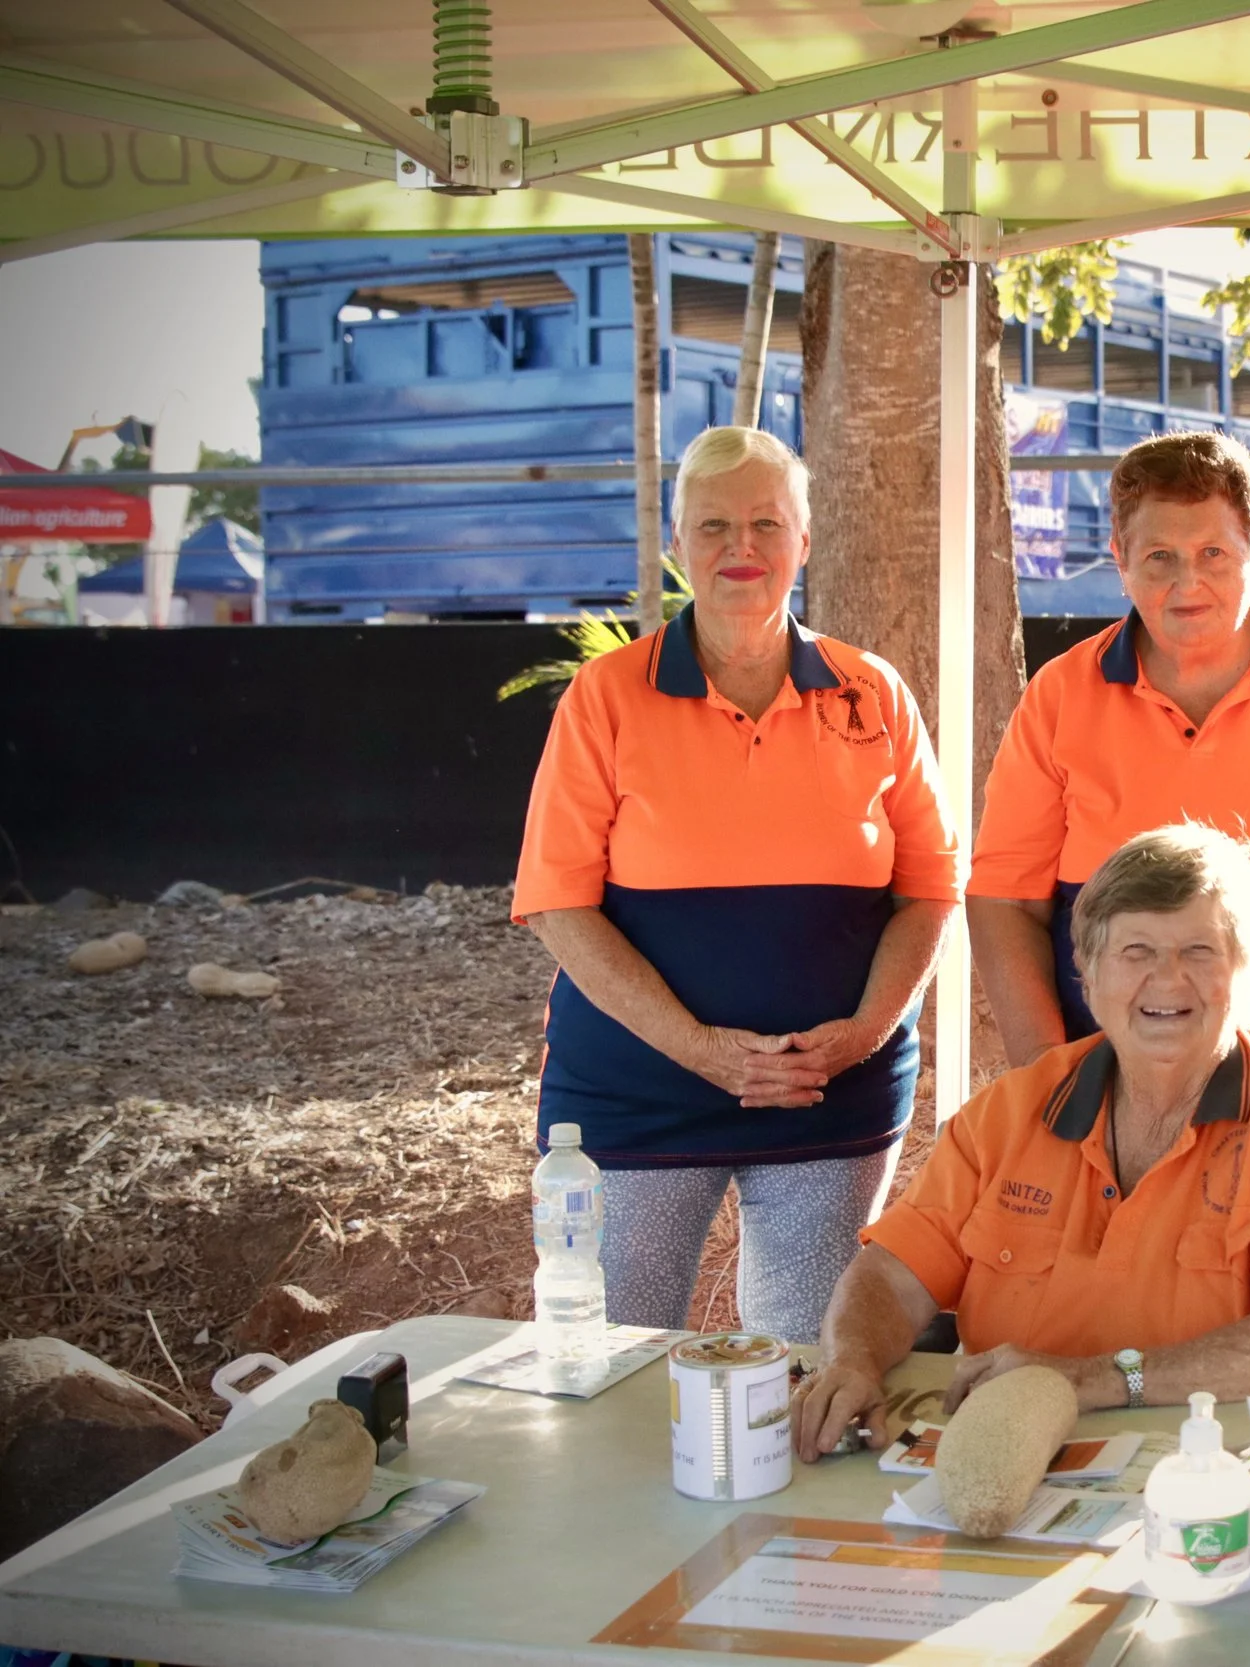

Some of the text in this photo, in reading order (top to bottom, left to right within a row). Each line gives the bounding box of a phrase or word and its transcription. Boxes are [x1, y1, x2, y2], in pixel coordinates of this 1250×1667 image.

[33, 505, 128, 532] agriculture
[1001, 1179, 1053, 1206] UNITED
[761, 1577, 806, 1587] THANK
[810, 1582, 838, 1590] YOU
[870, 1586, 908, 1595] GOLD
[911, 1590, 946, 1598] COIN
[787, 1600, 877, 1613] APPRECIATED
[879, 1607, 910, 1616] AND
[830, 1612, 856, 1620] THE
